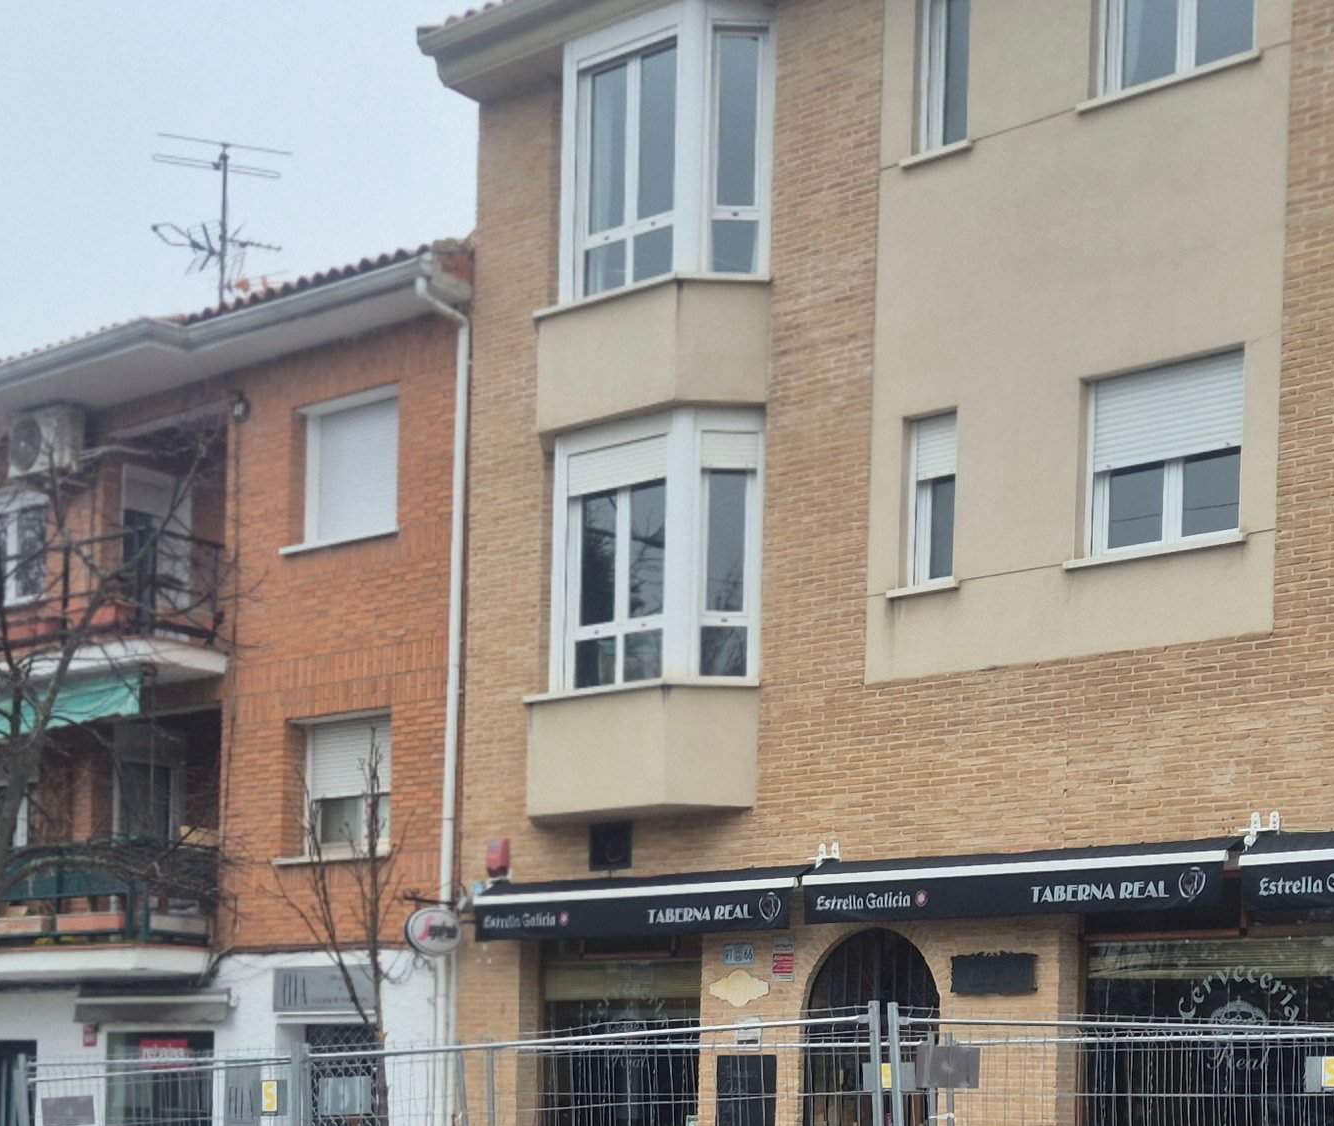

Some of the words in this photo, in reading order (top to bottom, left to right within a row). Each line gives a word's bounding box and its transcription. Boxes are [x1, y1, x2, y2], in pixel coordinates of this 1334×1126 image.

[1031, 881, 1116, 904] TABERNA
[1119, 879, 1170, 899] REAL
[1258, 875, 1325, 896] Estrella
[815, 894, 864, 912] Estrella
[866, 891, 911, 909] Galicia
[483, 913, 521, 928] Estrella
[522, 912, 556, 927] Galicia
[648, 904, 712, 925] TABERNA
[714, 902, 754, 921] REAL
